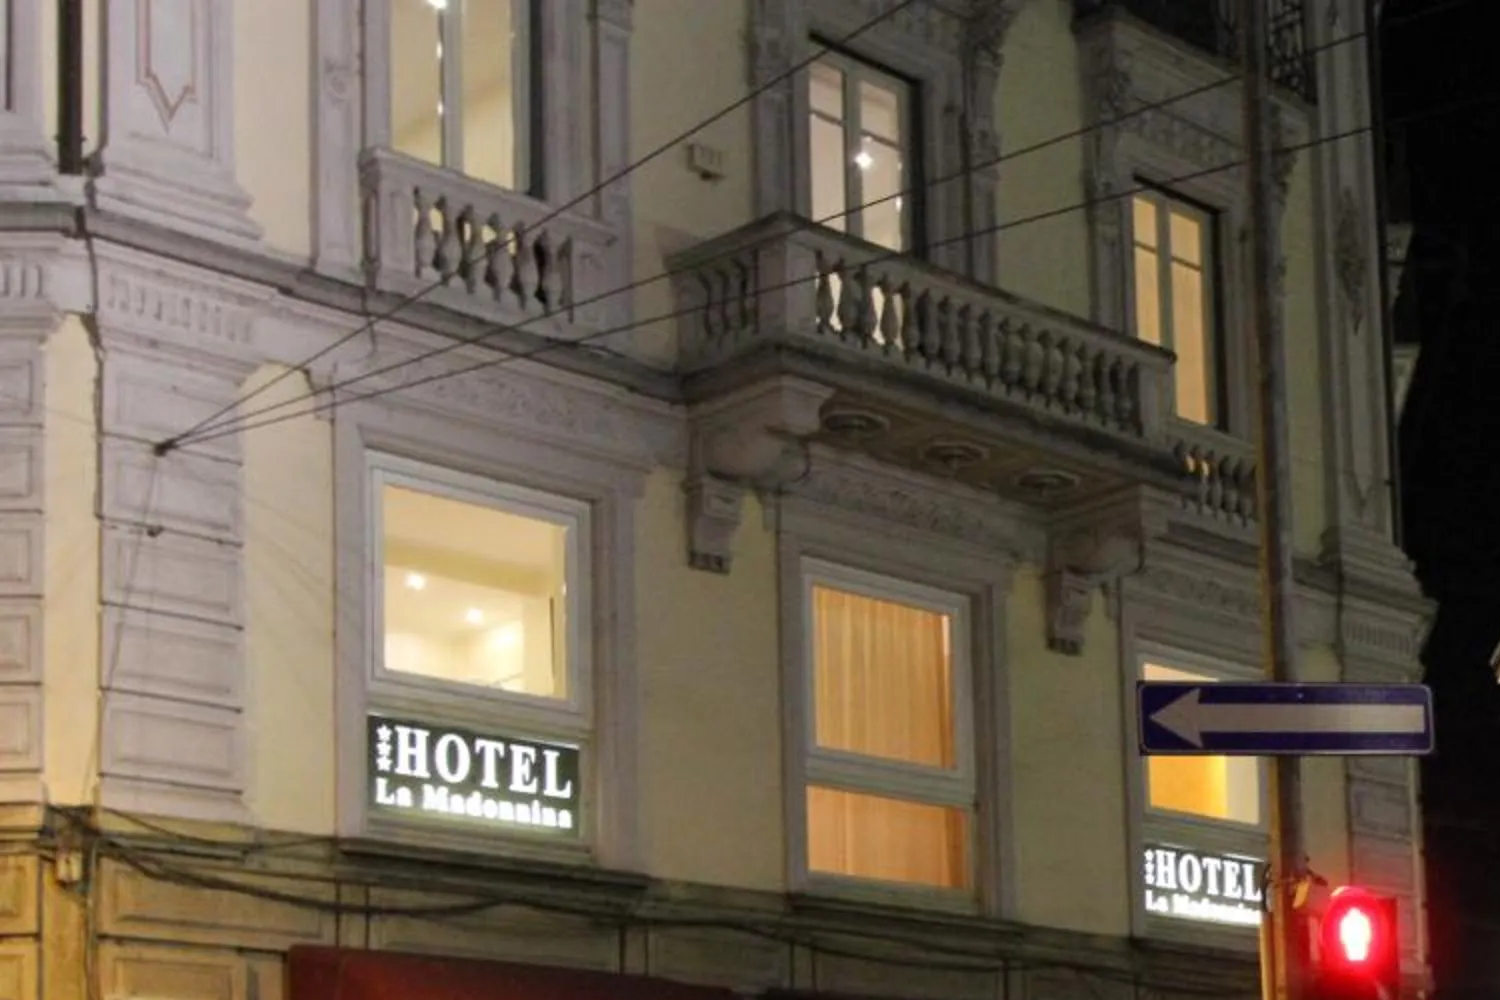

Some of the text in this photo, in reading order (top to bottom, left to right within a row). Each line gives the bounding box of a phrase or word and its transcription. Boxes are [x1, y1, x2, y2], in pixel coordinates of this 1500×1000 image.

[394, 724, 572, 799] HOTEL
[375, 777, 573, 829] La Madonnina
[1155, 849, 1263, 902] HOTEL
